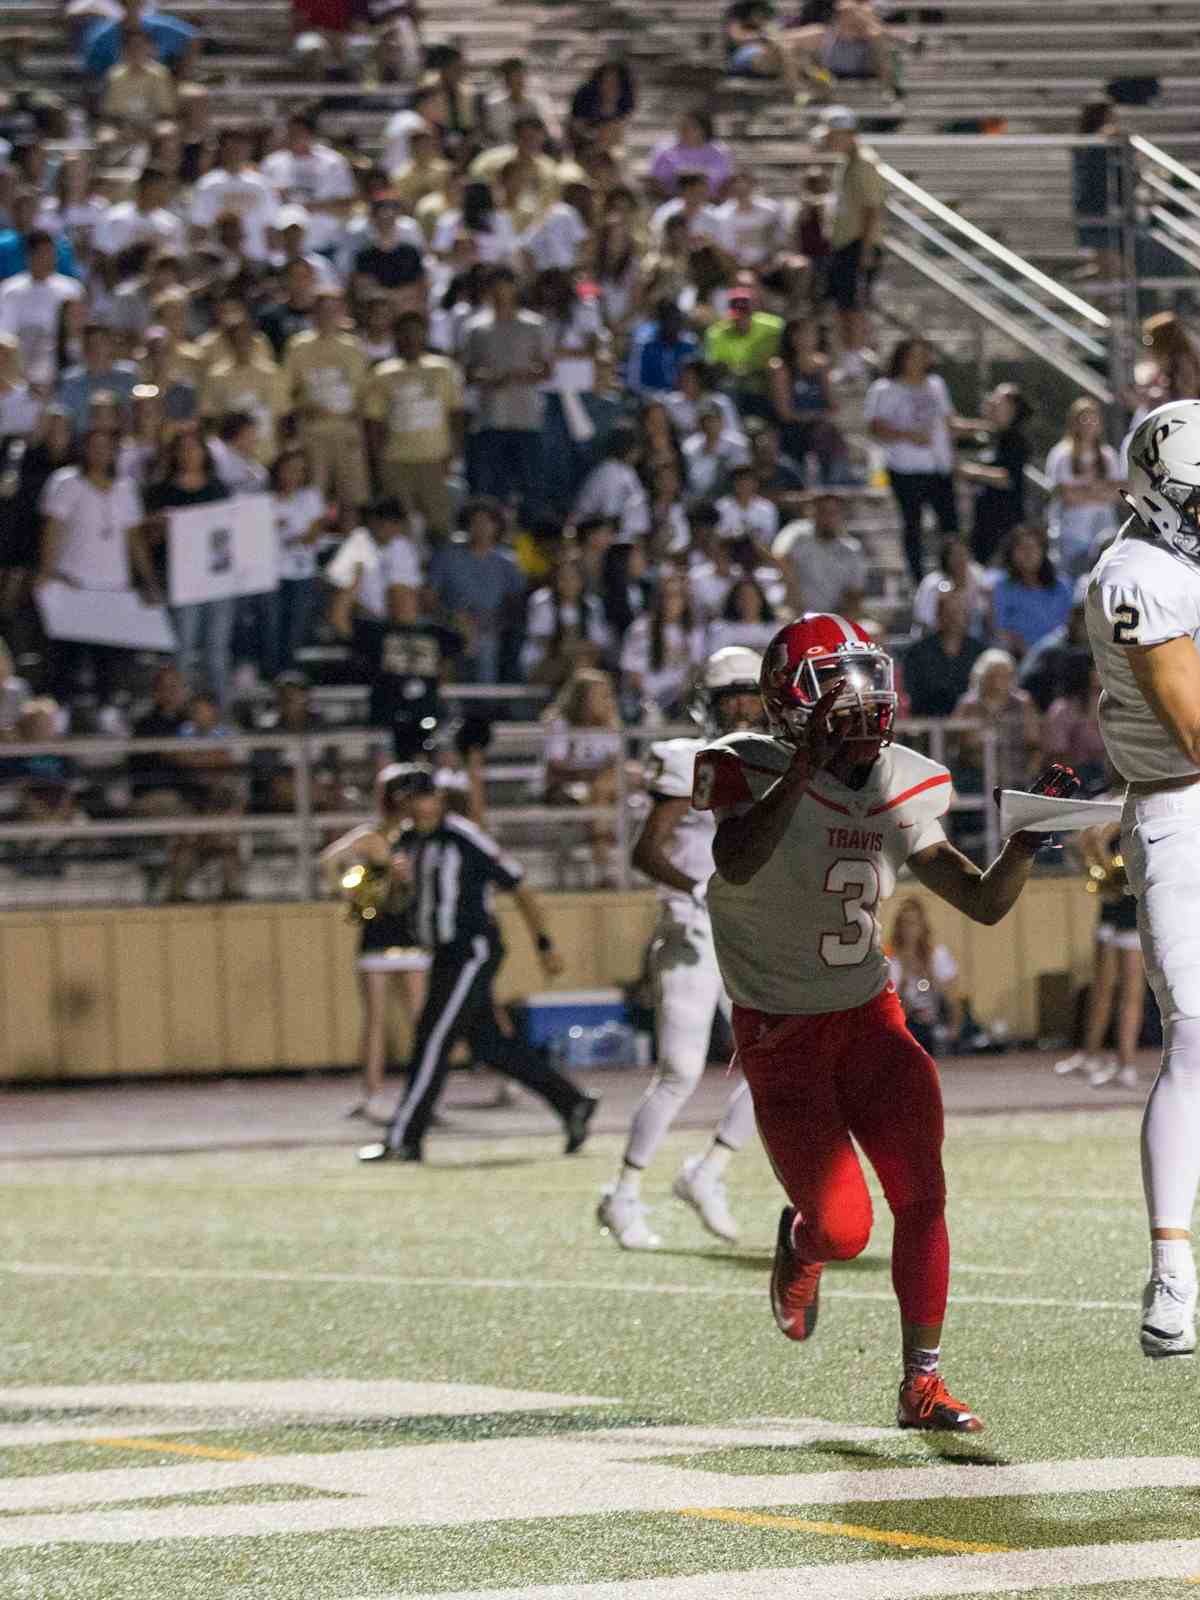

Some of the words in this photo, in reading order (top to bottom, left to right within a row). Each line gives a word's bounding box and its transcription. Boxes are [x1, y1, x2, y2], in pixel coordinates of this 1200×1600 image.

[1113, 603, 1140, 645] 2
[825, 826, 884, 852] TRAVIS
[817, 857, 881, 968] 3
